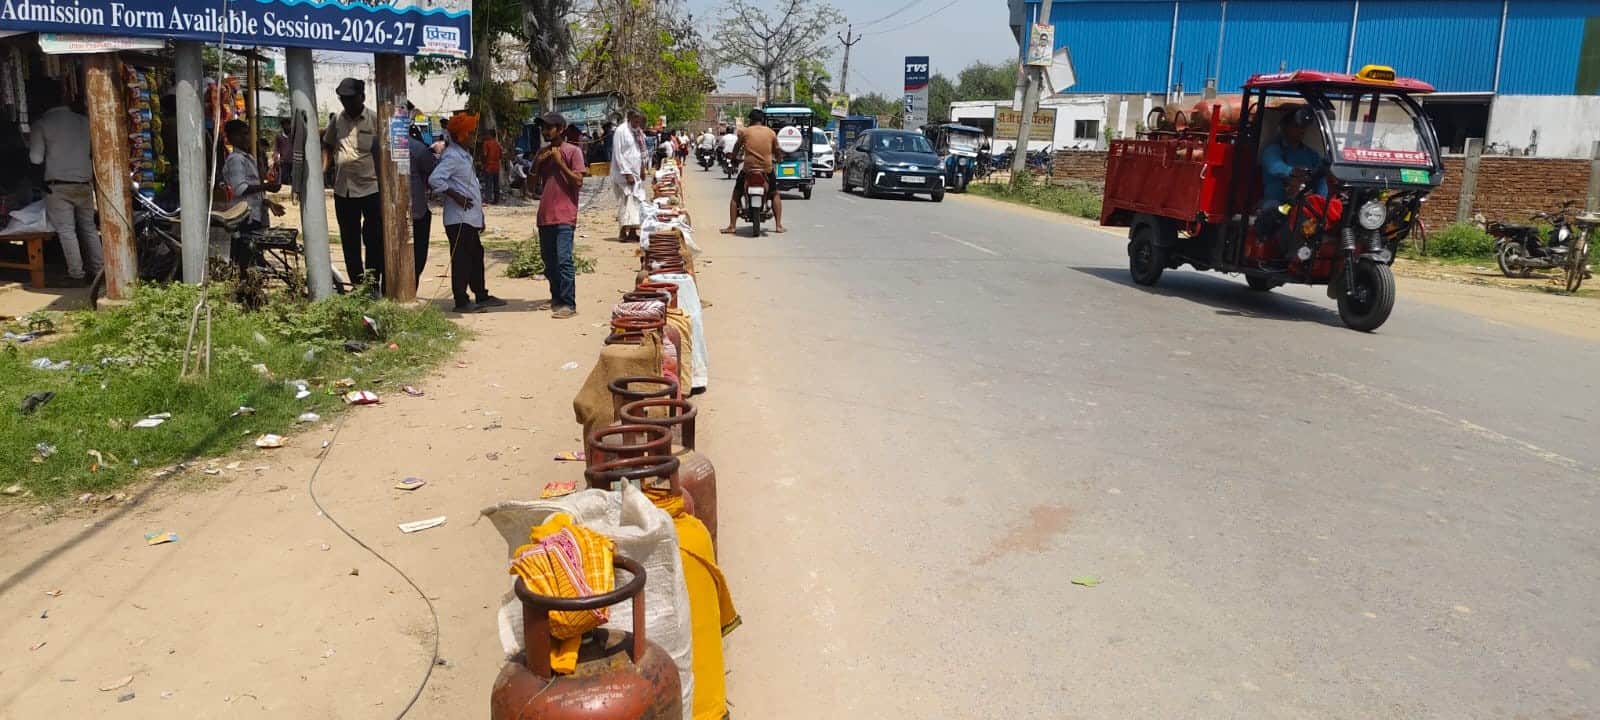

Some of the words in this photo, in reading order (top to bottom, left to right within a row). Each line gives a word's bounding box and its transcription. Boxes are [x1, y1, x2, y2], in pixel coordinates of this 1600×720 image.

[1, 0, 105, 26] Admission
[110, 2, 165, 29] Form
[167, 6, 258, 35] Available
[263, 11, 416, 47] Session-2026-27
[906, 63, 928, 73] TVS
